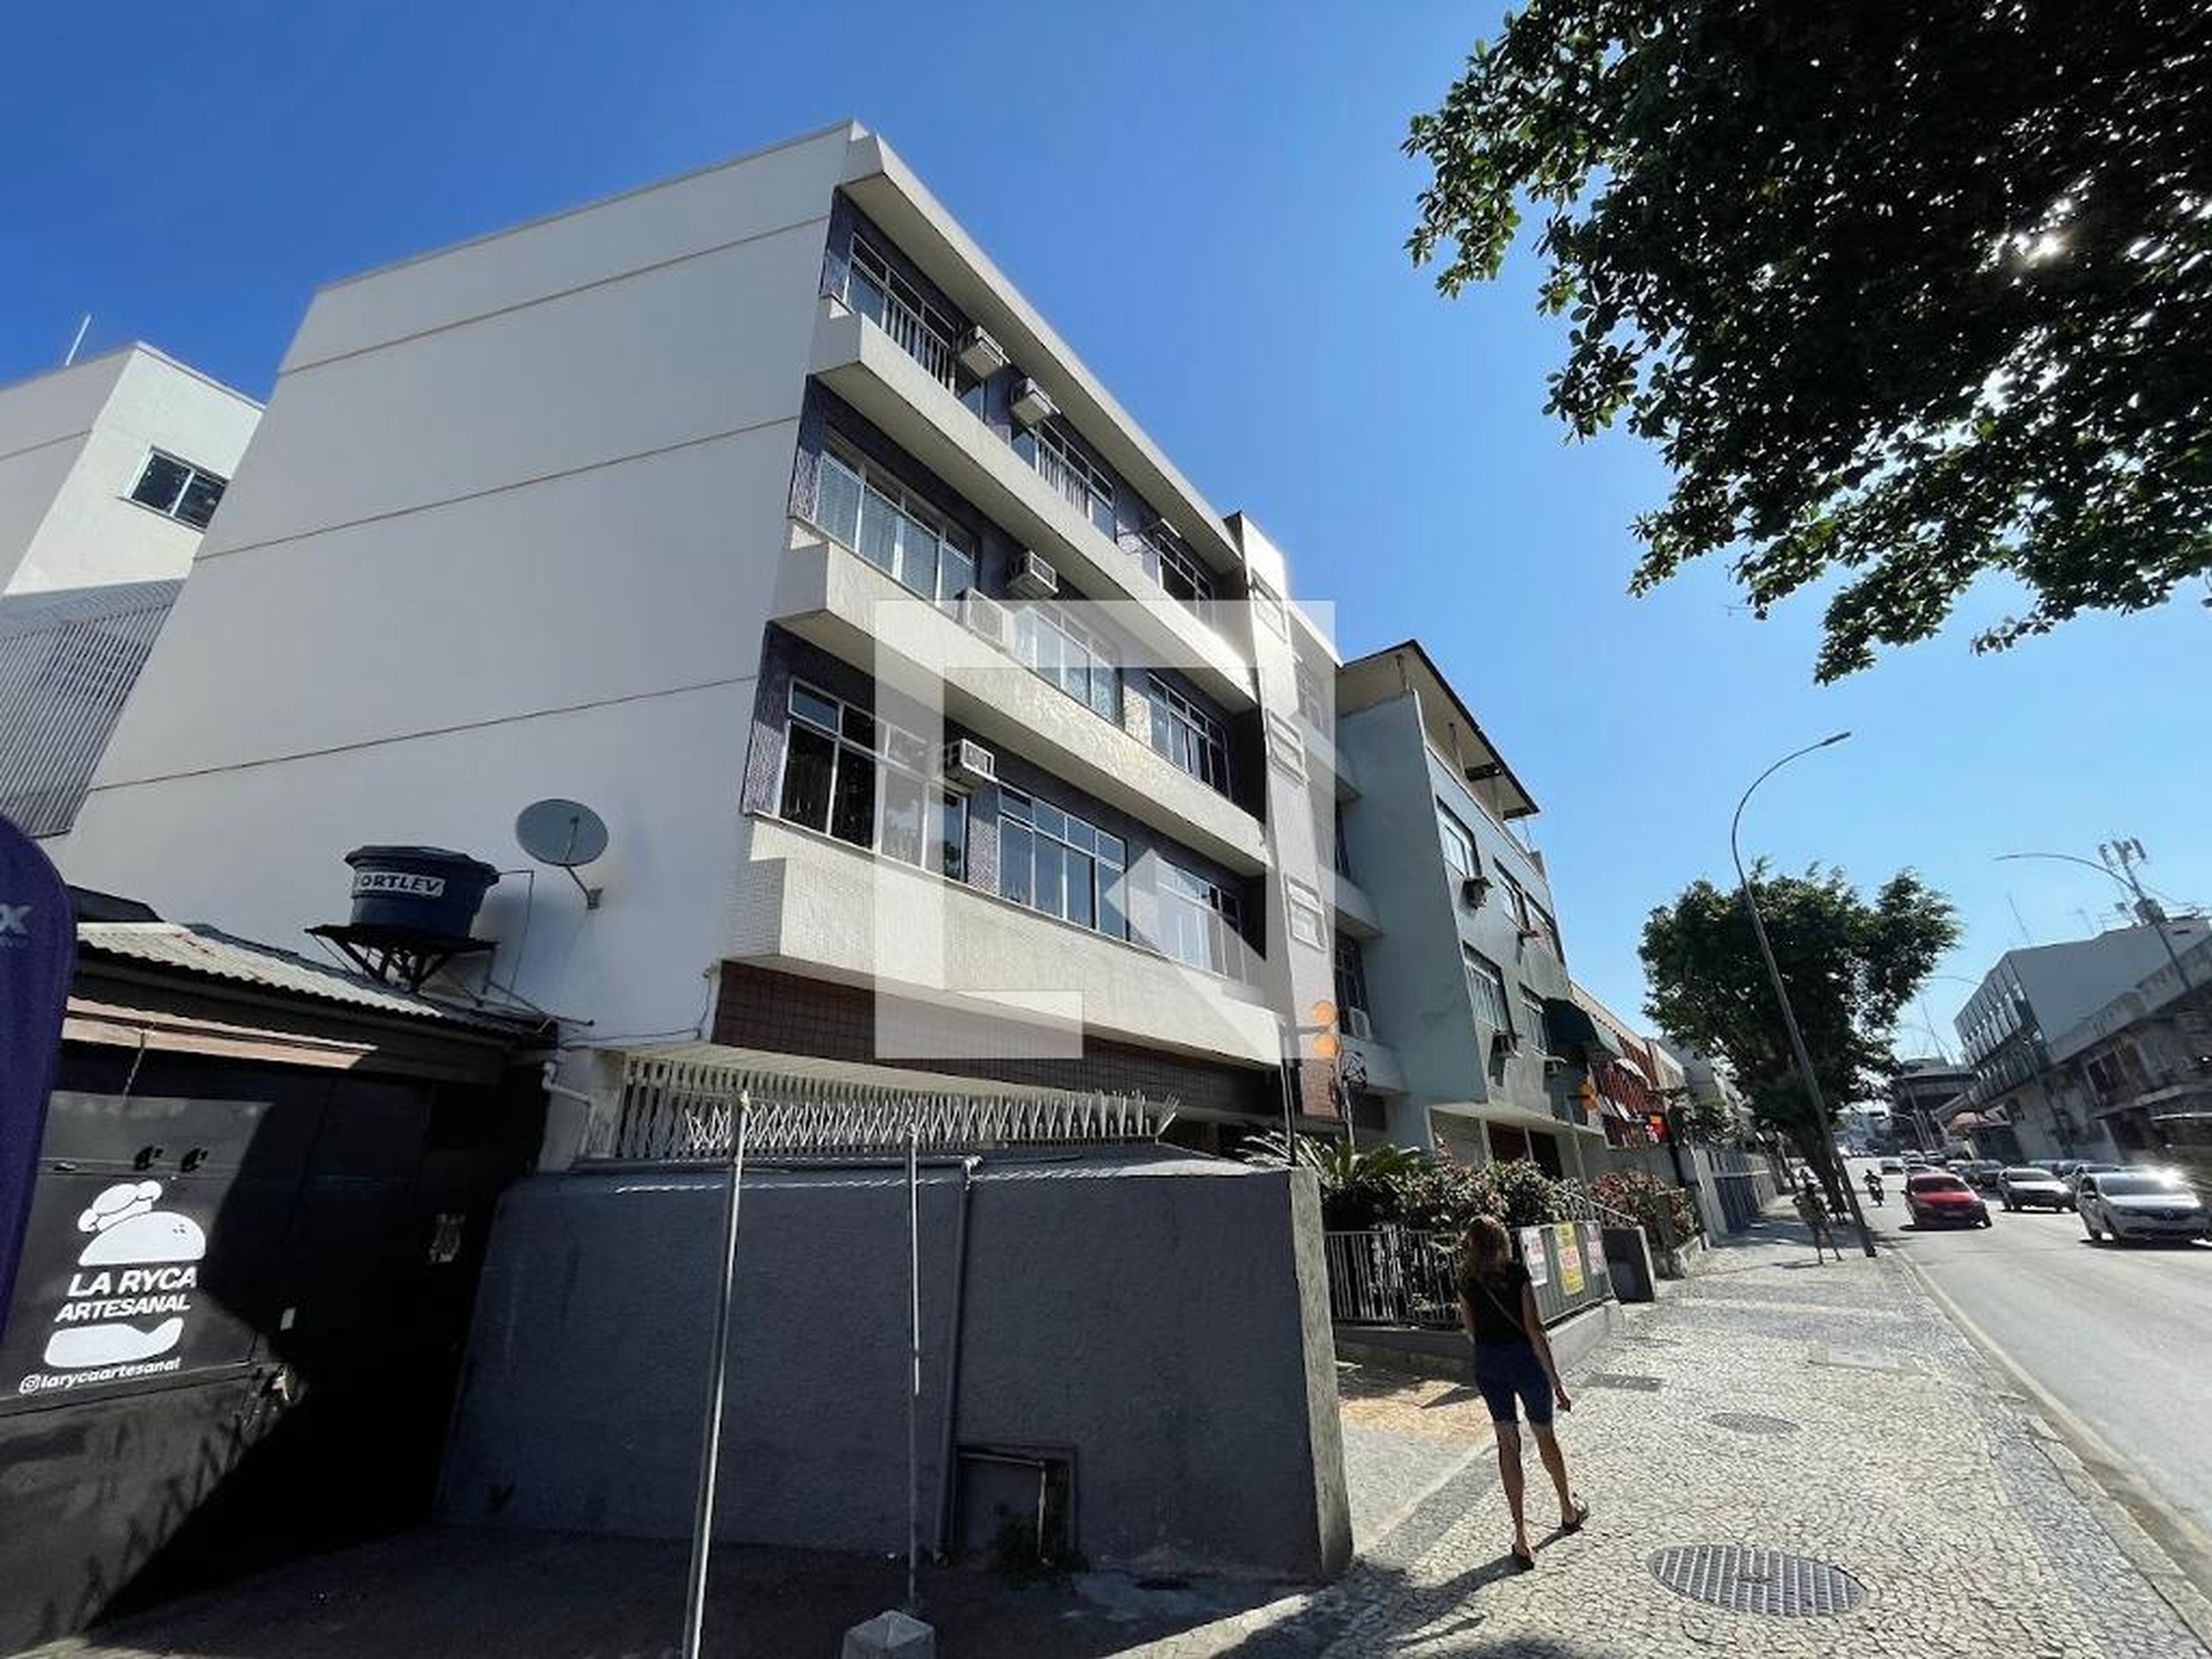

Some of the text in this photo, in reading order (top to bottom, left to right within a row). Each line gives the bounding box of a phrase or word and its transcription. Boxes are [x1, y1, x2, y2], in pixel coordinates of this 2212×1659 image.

[356, 874, 442, 892] ORTLEV
[67, 1267, 197, 1297] LA RYCA
[54, 1294, 191, 1323] ARTESANAL
